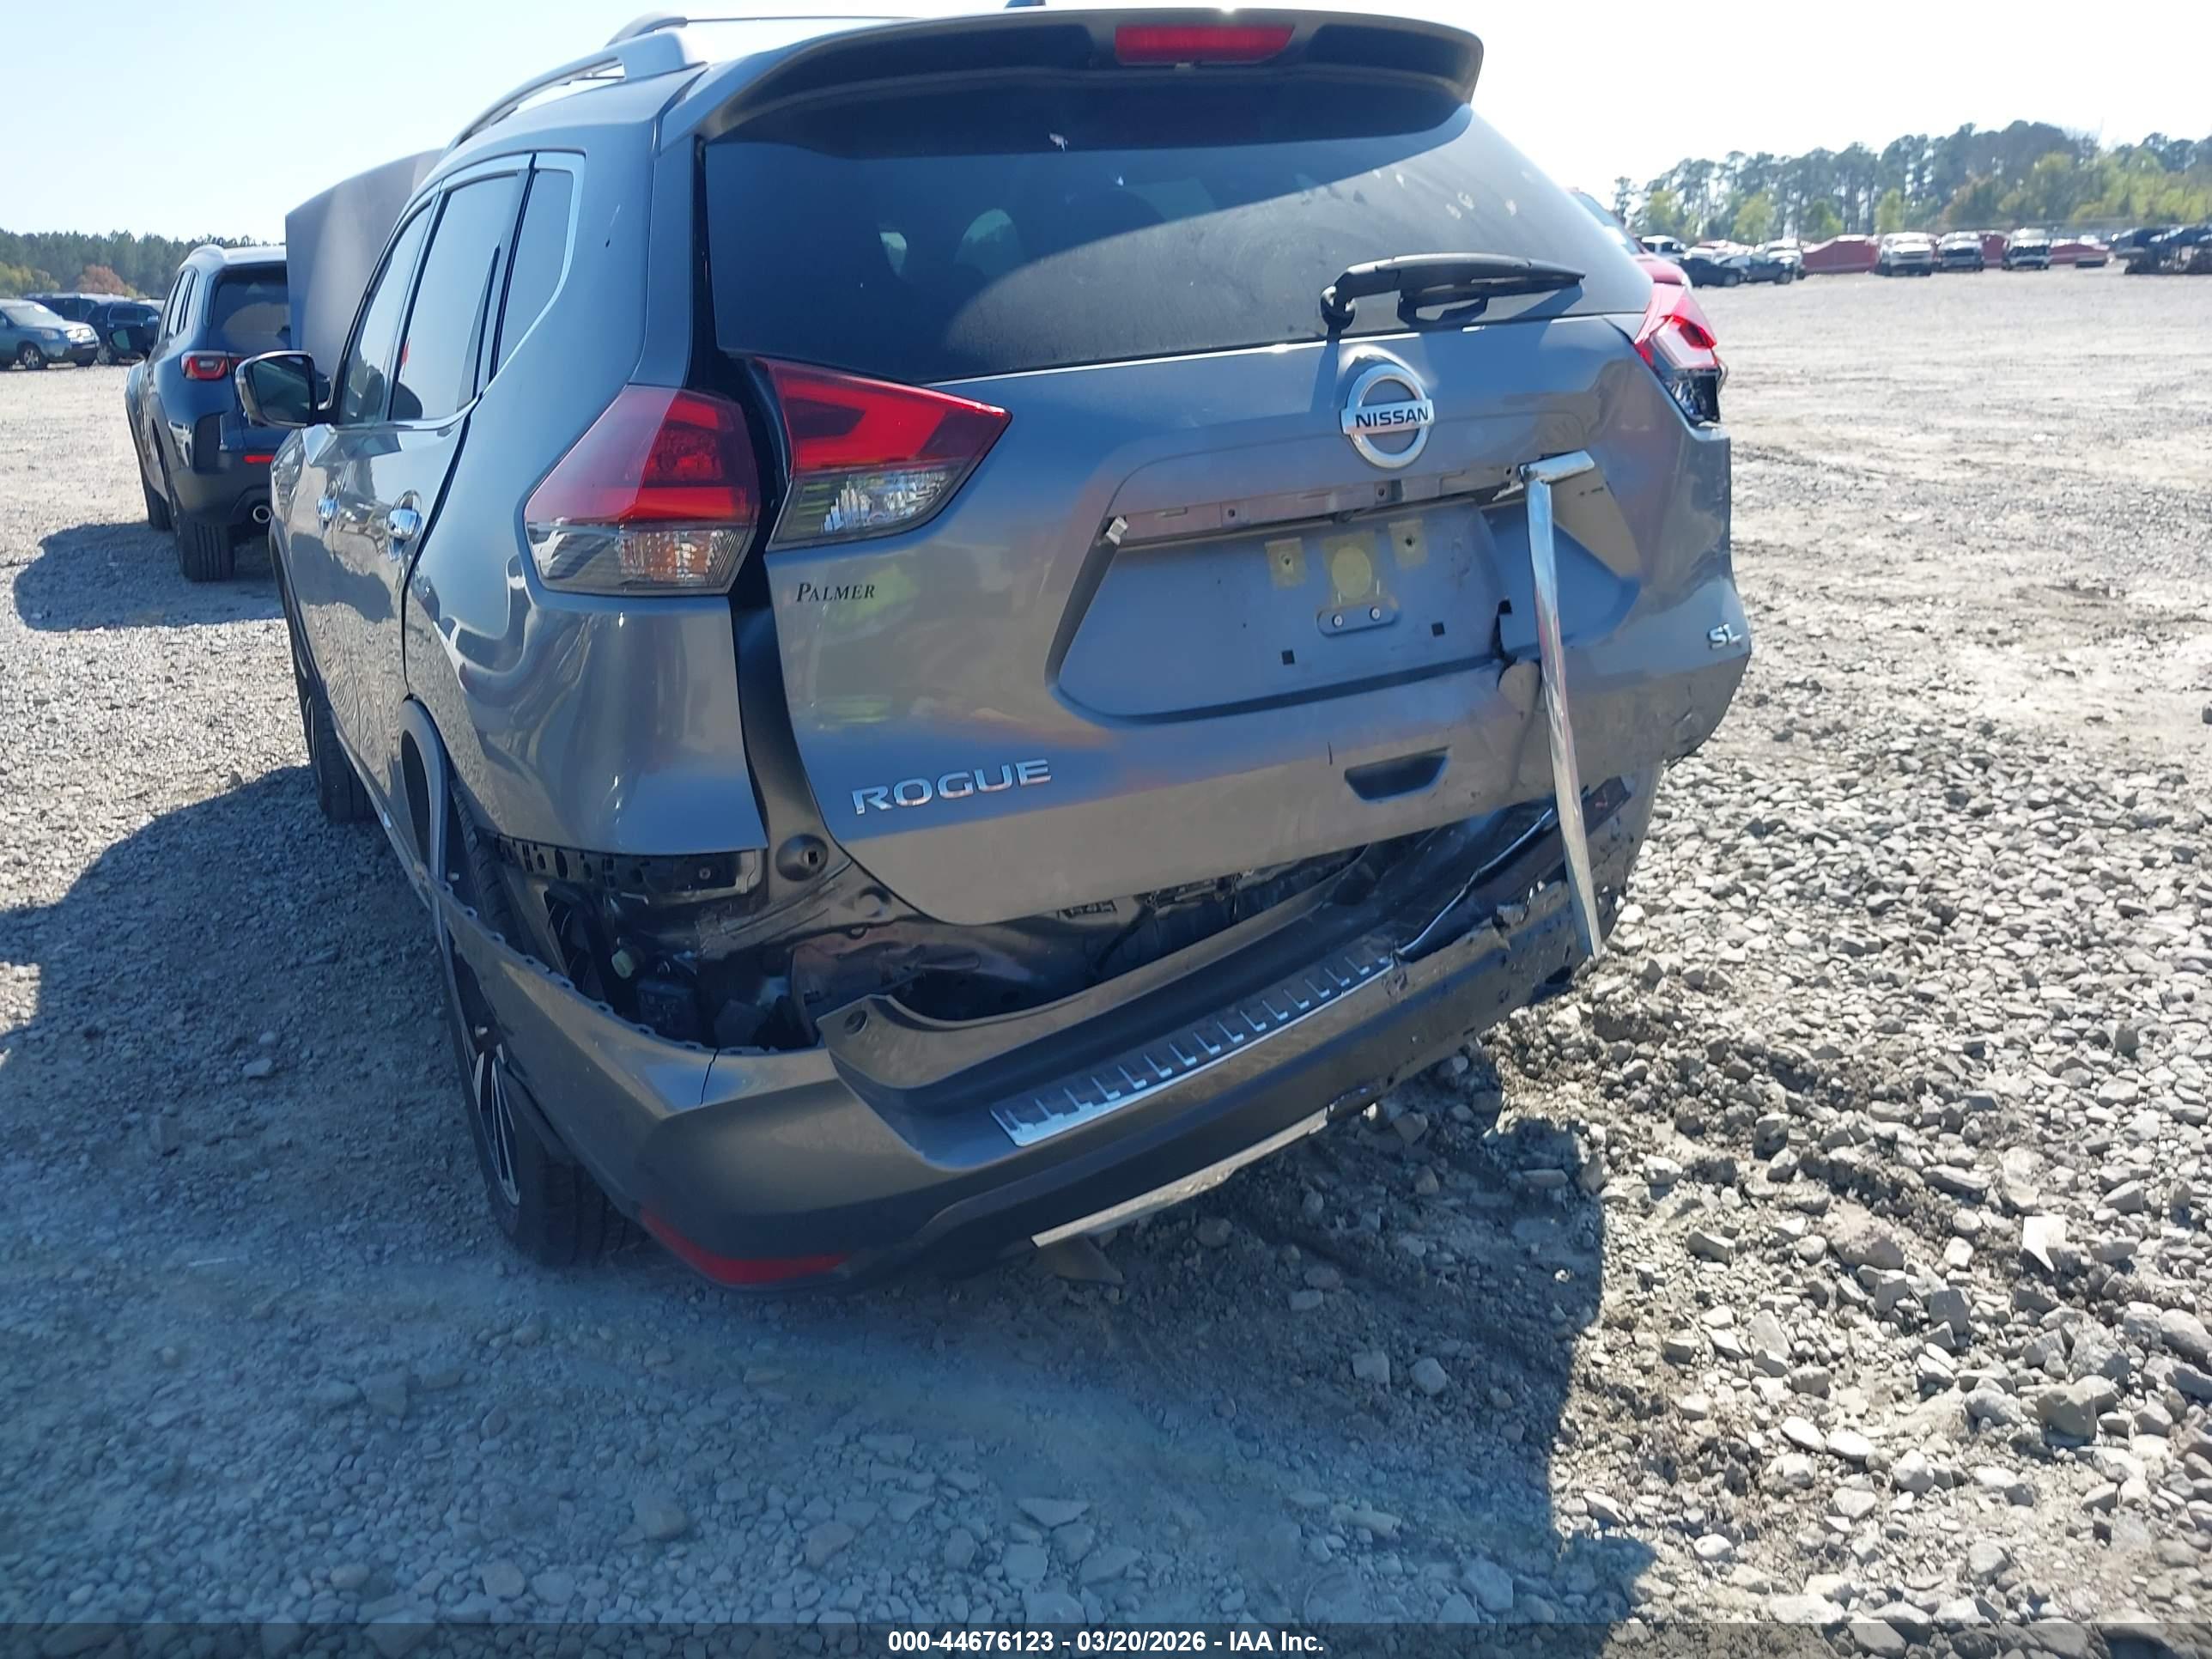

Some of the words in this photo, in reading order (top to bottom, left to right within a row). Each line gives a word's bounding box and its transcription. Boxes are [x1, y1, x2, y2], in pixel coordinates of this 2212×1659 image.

[1355, 407, 1429, 428] NISSAN
[1708, 623, 1742, 650] SL
[851, 758, 1053, 815] ROGUE
